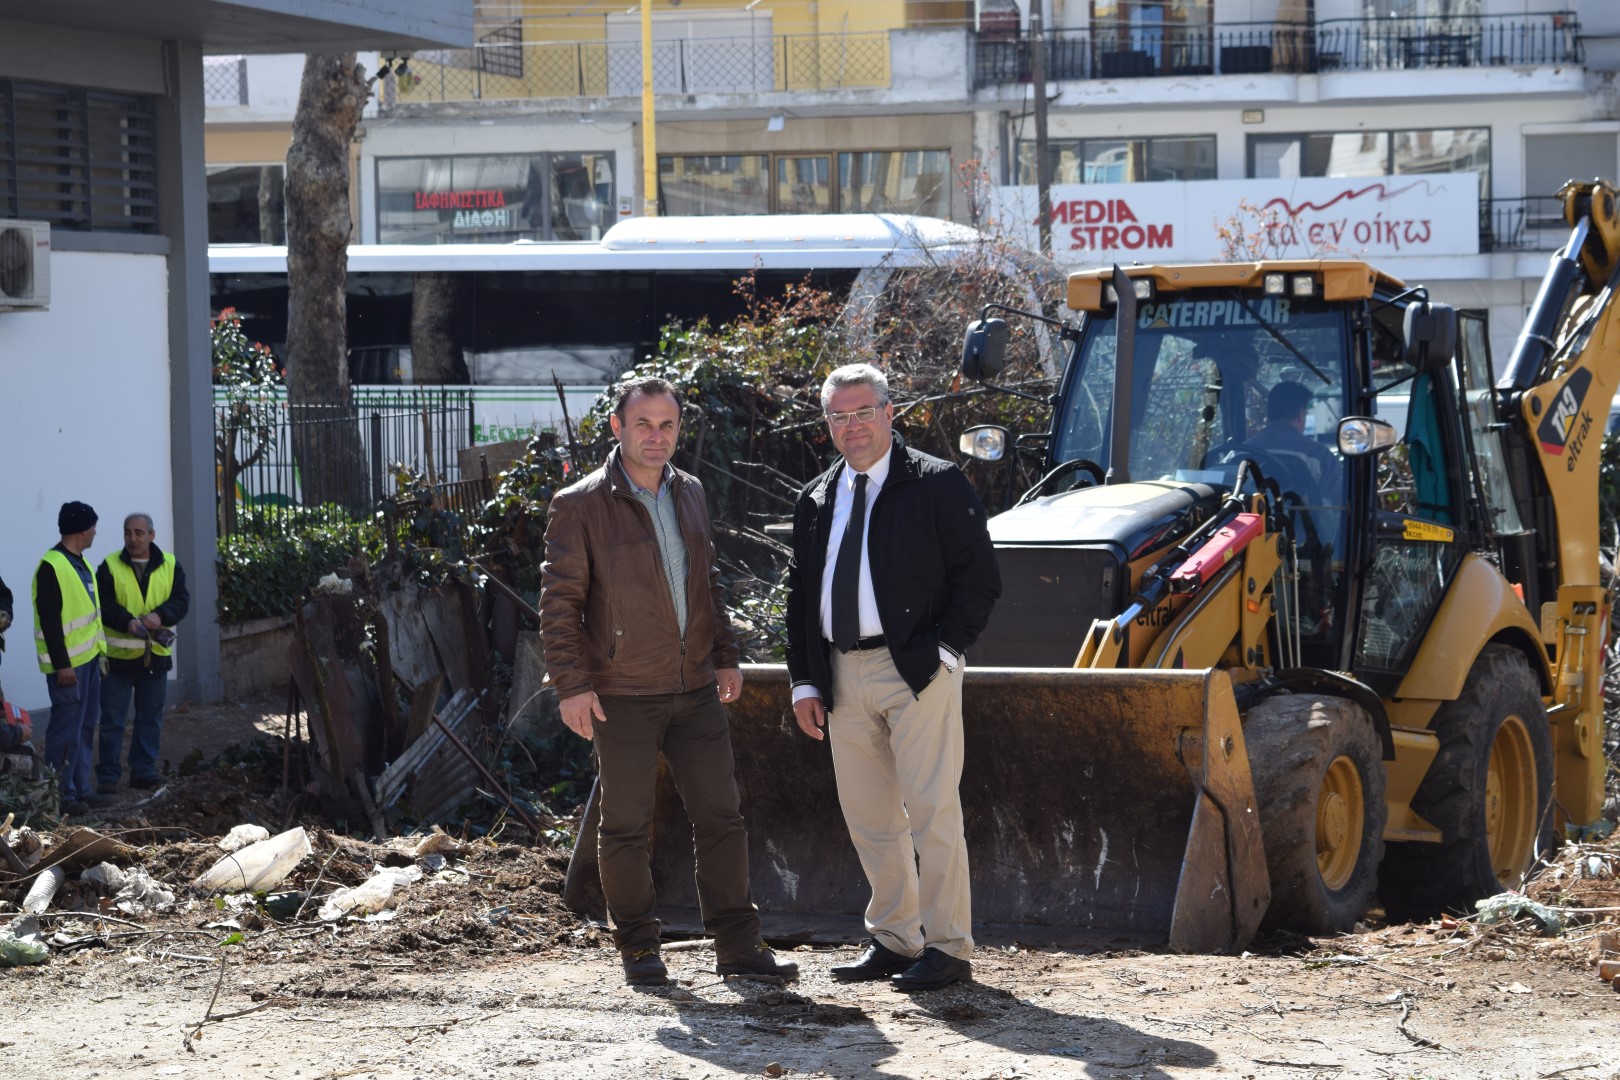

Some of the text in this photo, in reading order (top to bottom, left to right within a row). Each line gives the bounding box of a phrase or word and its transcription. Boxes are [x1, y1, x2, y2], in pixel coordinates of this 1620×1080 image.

[453, 210, 510, 228] ΔΙΑΦΗ
[1032, 199, 1138, 226] MEDIA
[1071, 224, 1174, 250] STROM
[1138, 299, 1291, 329] CATERPILLAR
[1567, 408, 1594, 472] eltrak
